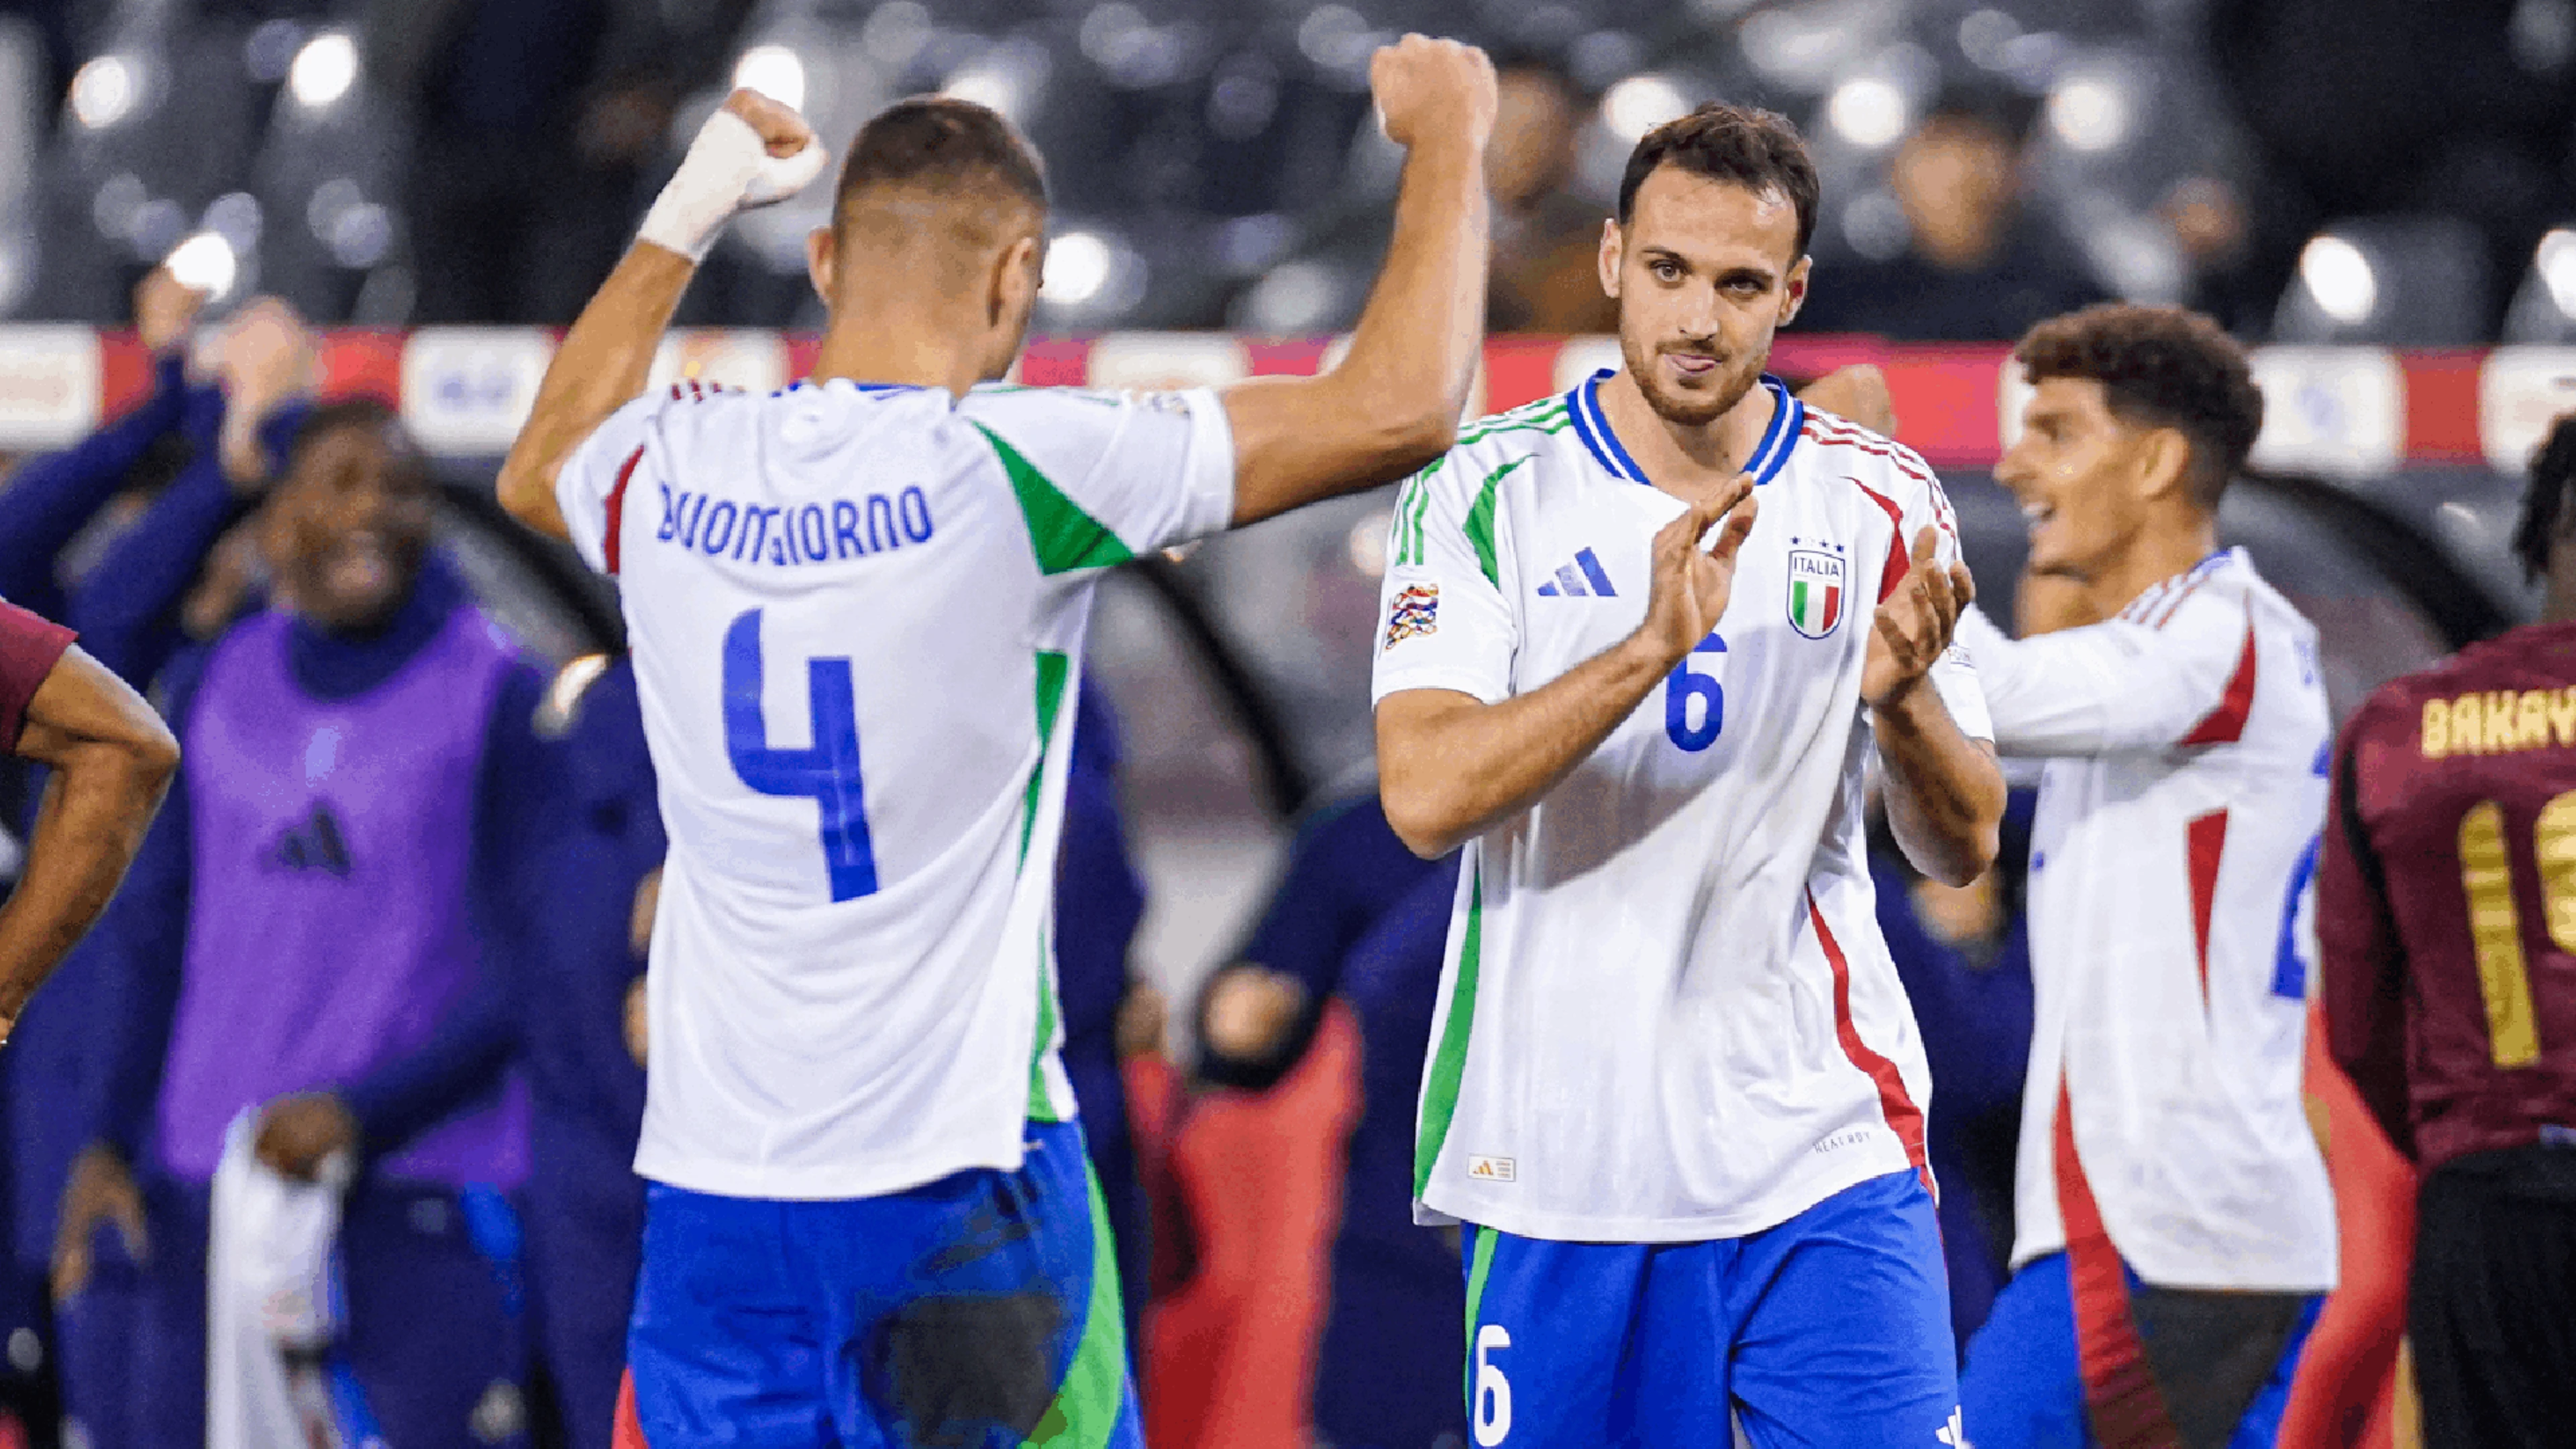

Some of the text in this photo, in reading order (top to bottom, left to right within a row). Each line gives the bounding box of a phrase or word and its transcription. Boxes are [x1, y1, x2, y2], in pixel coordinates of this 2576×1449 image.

[1793, 556, 1840, 576] ITALIA
[1666, 632, 1727, 752] 6
[722, 607, 881, 904] 4
[1474, 1325, 1511, 1447] 6
